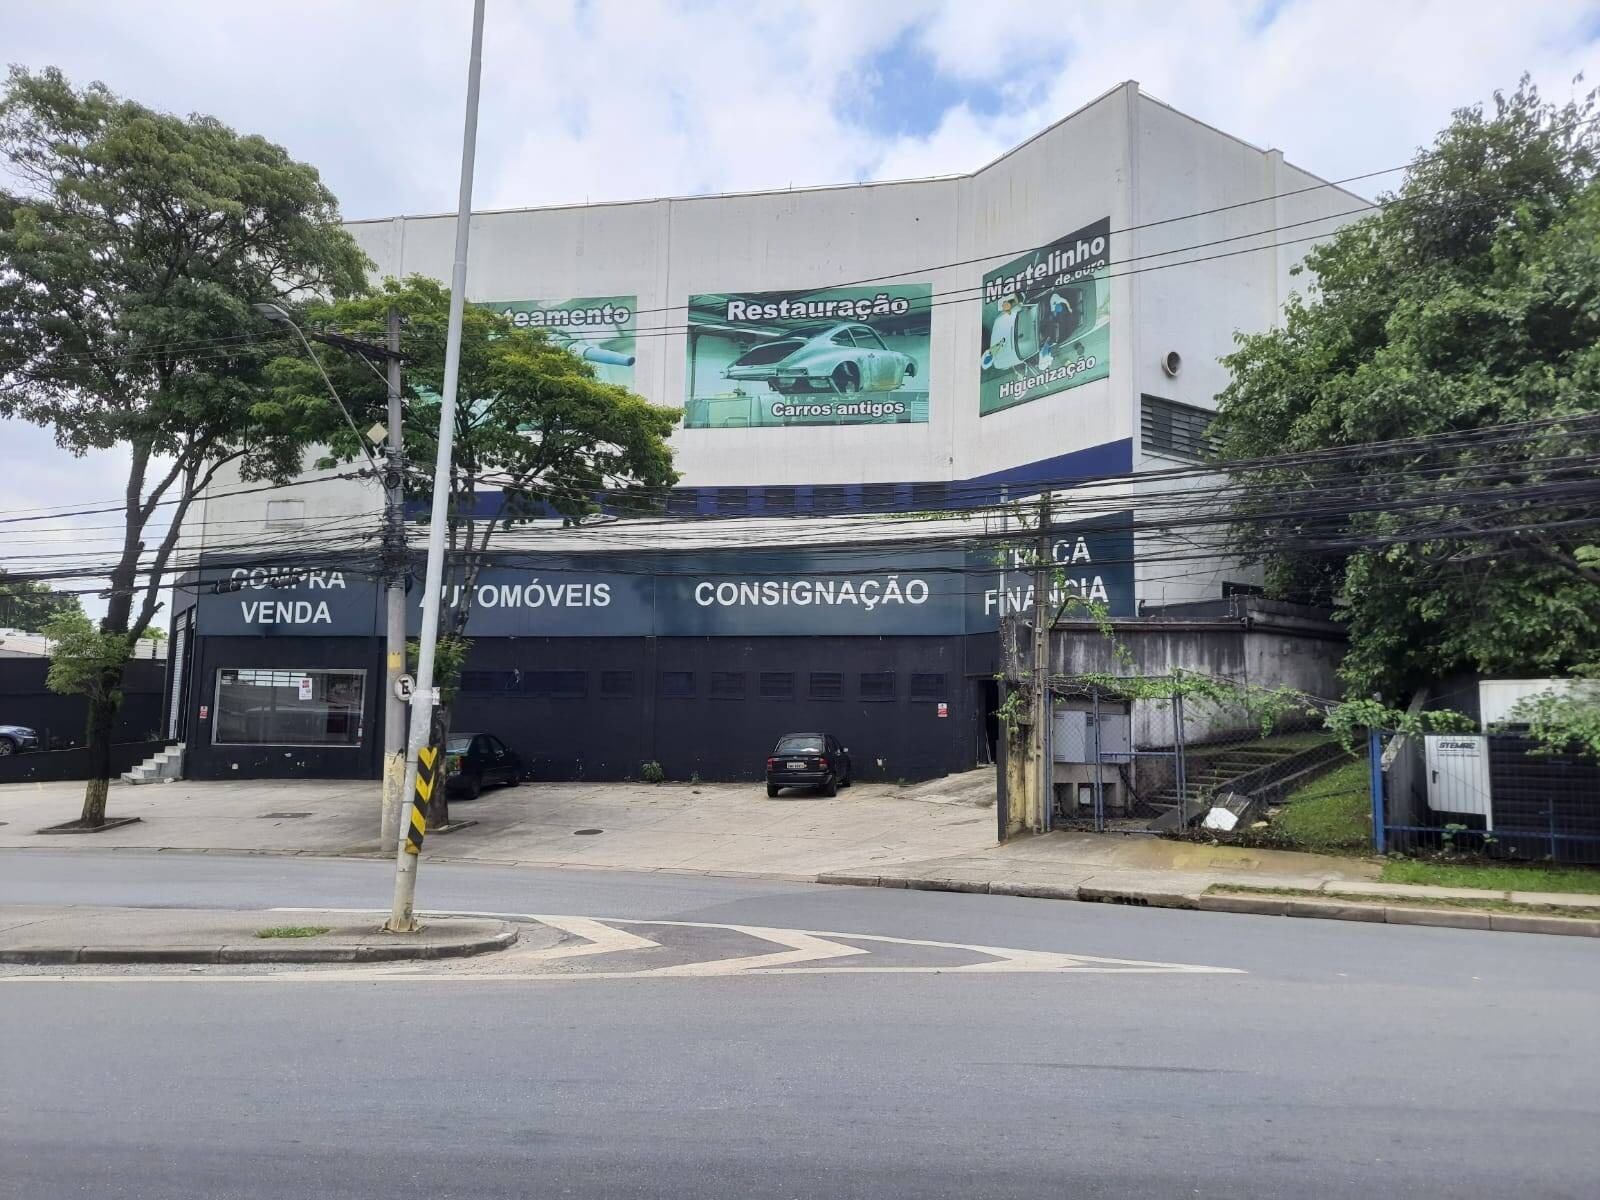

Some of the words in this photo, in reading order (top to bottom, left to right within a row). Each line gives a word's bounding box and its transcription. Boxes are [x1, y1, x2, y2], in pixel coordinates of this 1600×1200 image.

[985, 236, 1105, 304] Martelinho
[1055, 273, 1072, 286] de
[1074, 259, 1105, 279] ouro
[503, 302, 631, 327] teamento
[726, 293, 910, 321] Restauração
[999, 356, 1097, 398] Higienização
[772, 401, 832, 417] Carros
[837, 400, 905, 417] antigos
[694, 574, 929, 611] CONSIGNAÇÃO
[240, 600, 333, 624] VENDA
